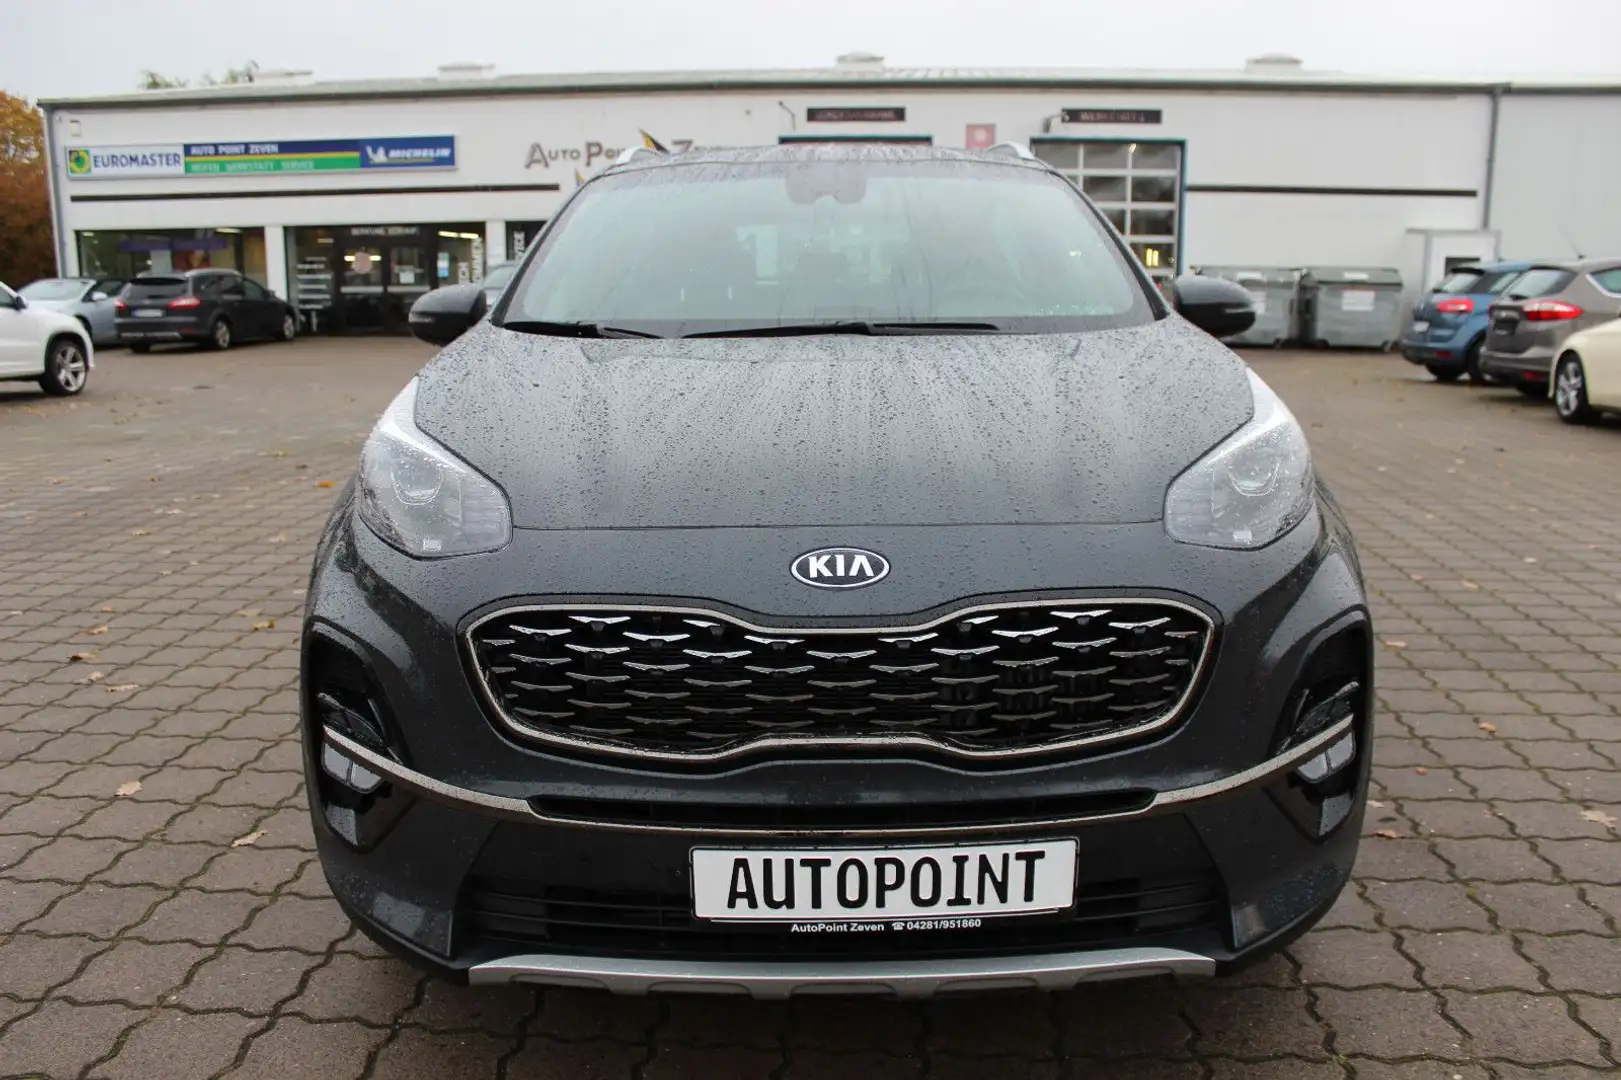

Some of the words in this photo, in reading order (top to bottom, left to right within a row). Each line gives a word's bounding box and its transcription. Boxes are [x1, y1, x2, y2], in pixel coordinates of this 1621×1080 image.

[190, 145, 215, 155] AUTO
[218, 144, 245, 154] POINT
[249, 143, 278, 154] ZEVEN
[388, 148, 451, 158] MICHELIN
[94, 152, 181, 168] EUROMASTER
[808, 554, 875, 578] KIA
[727, 850, 1046, 910] AUTOPOINT
[791, 922, 848, 933] AutoPoint
[850, 922, 885, 932] Zeven
[906, 918, 982, 931] 04281/951860
